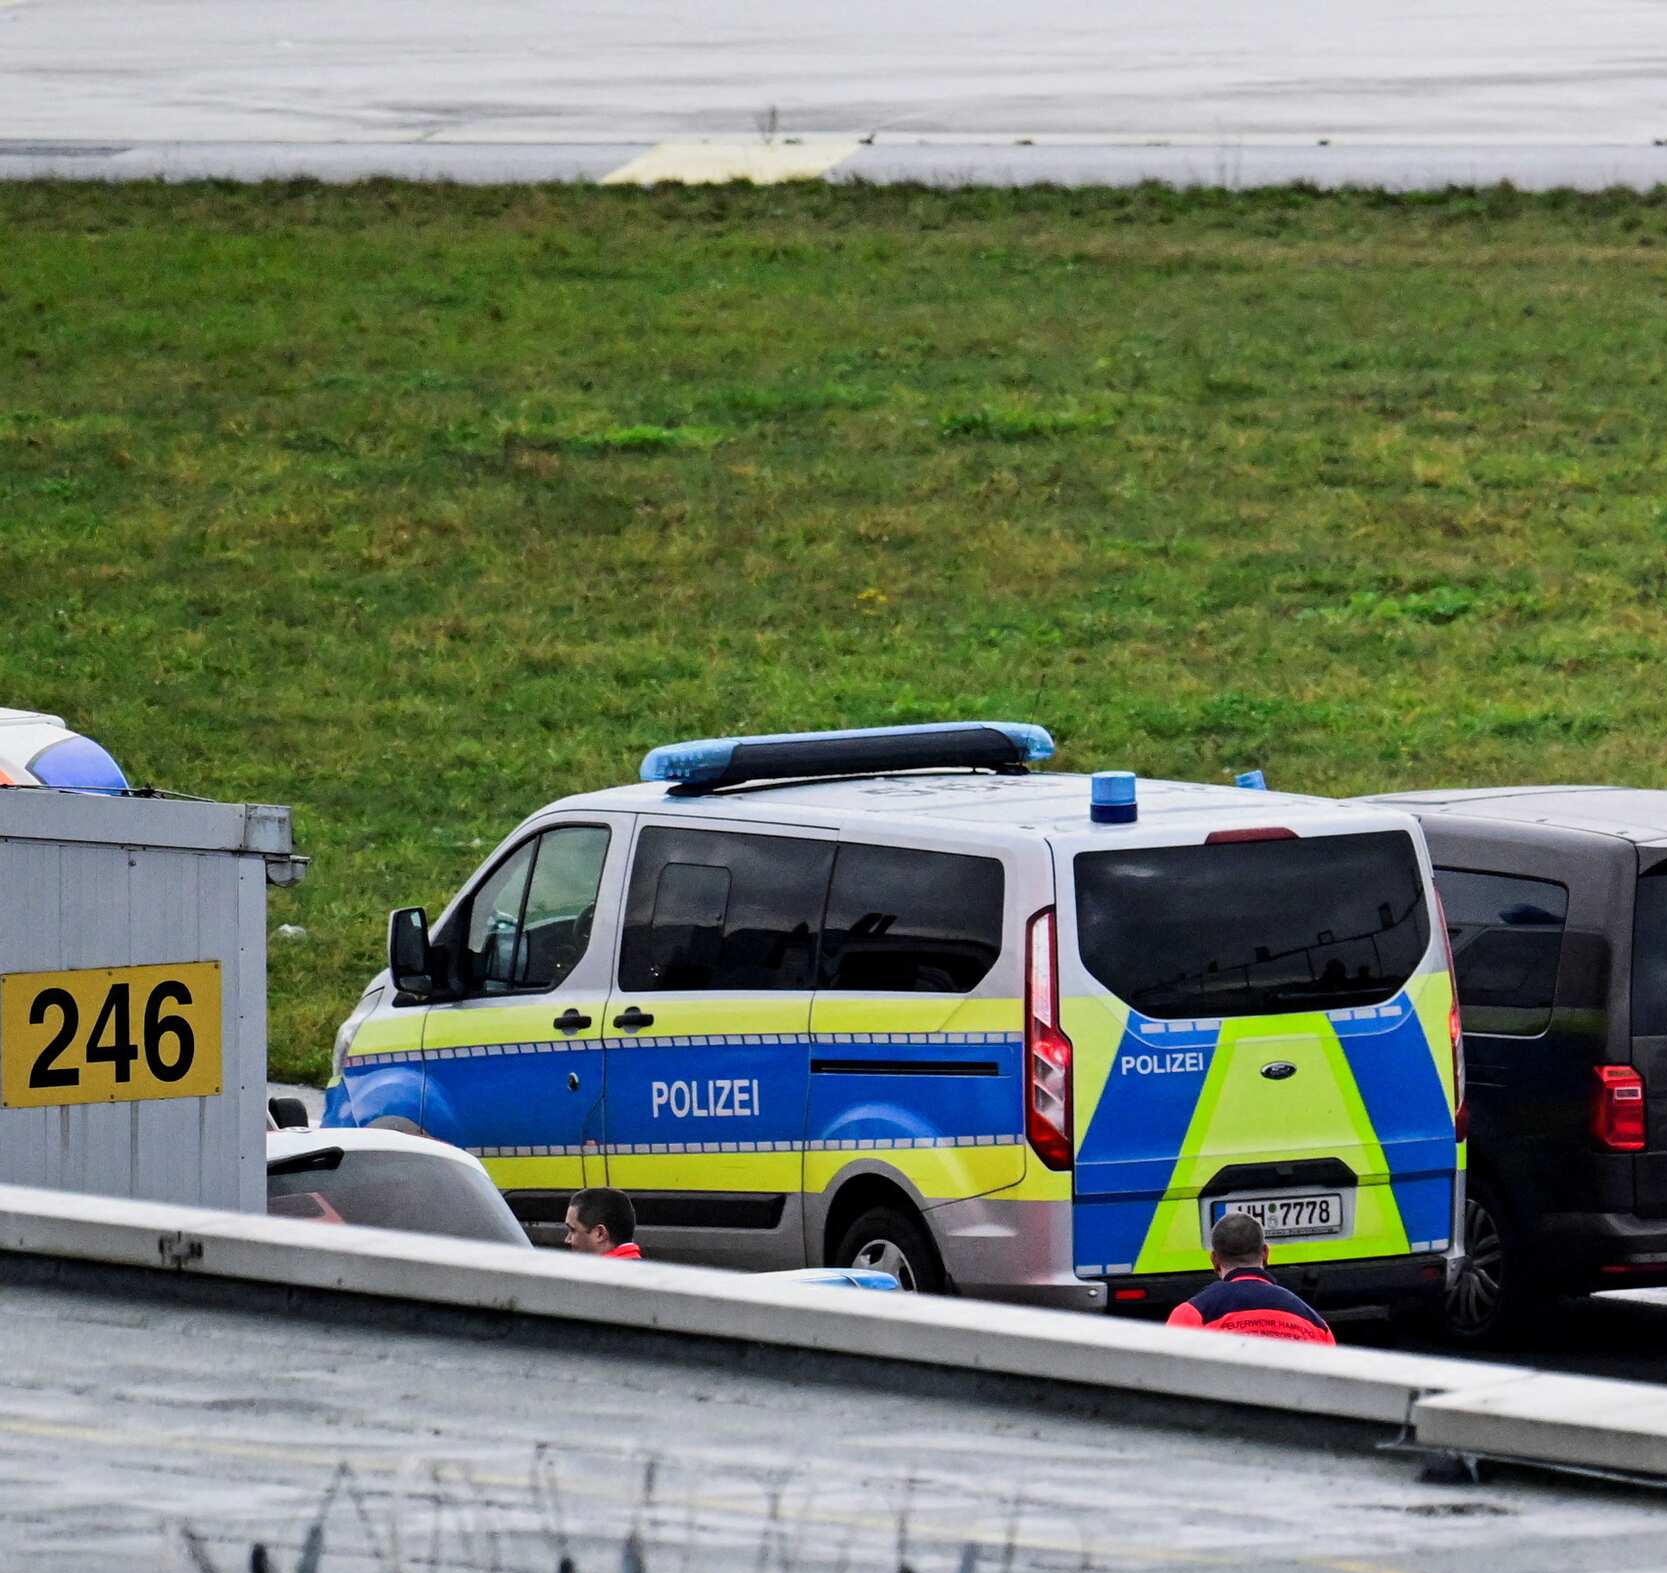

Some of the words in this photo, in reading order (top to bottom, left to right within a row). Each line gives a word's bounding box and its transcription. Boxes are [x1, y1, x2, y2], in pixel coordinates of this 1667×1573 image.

[29, 980, 195, 1089] 246
[1121, 1053, 1204, 1076] POLIZEI
[651, 1079, 760, 1119] POLIZEI
[1279, 1199, 1331, 1227] 7778
